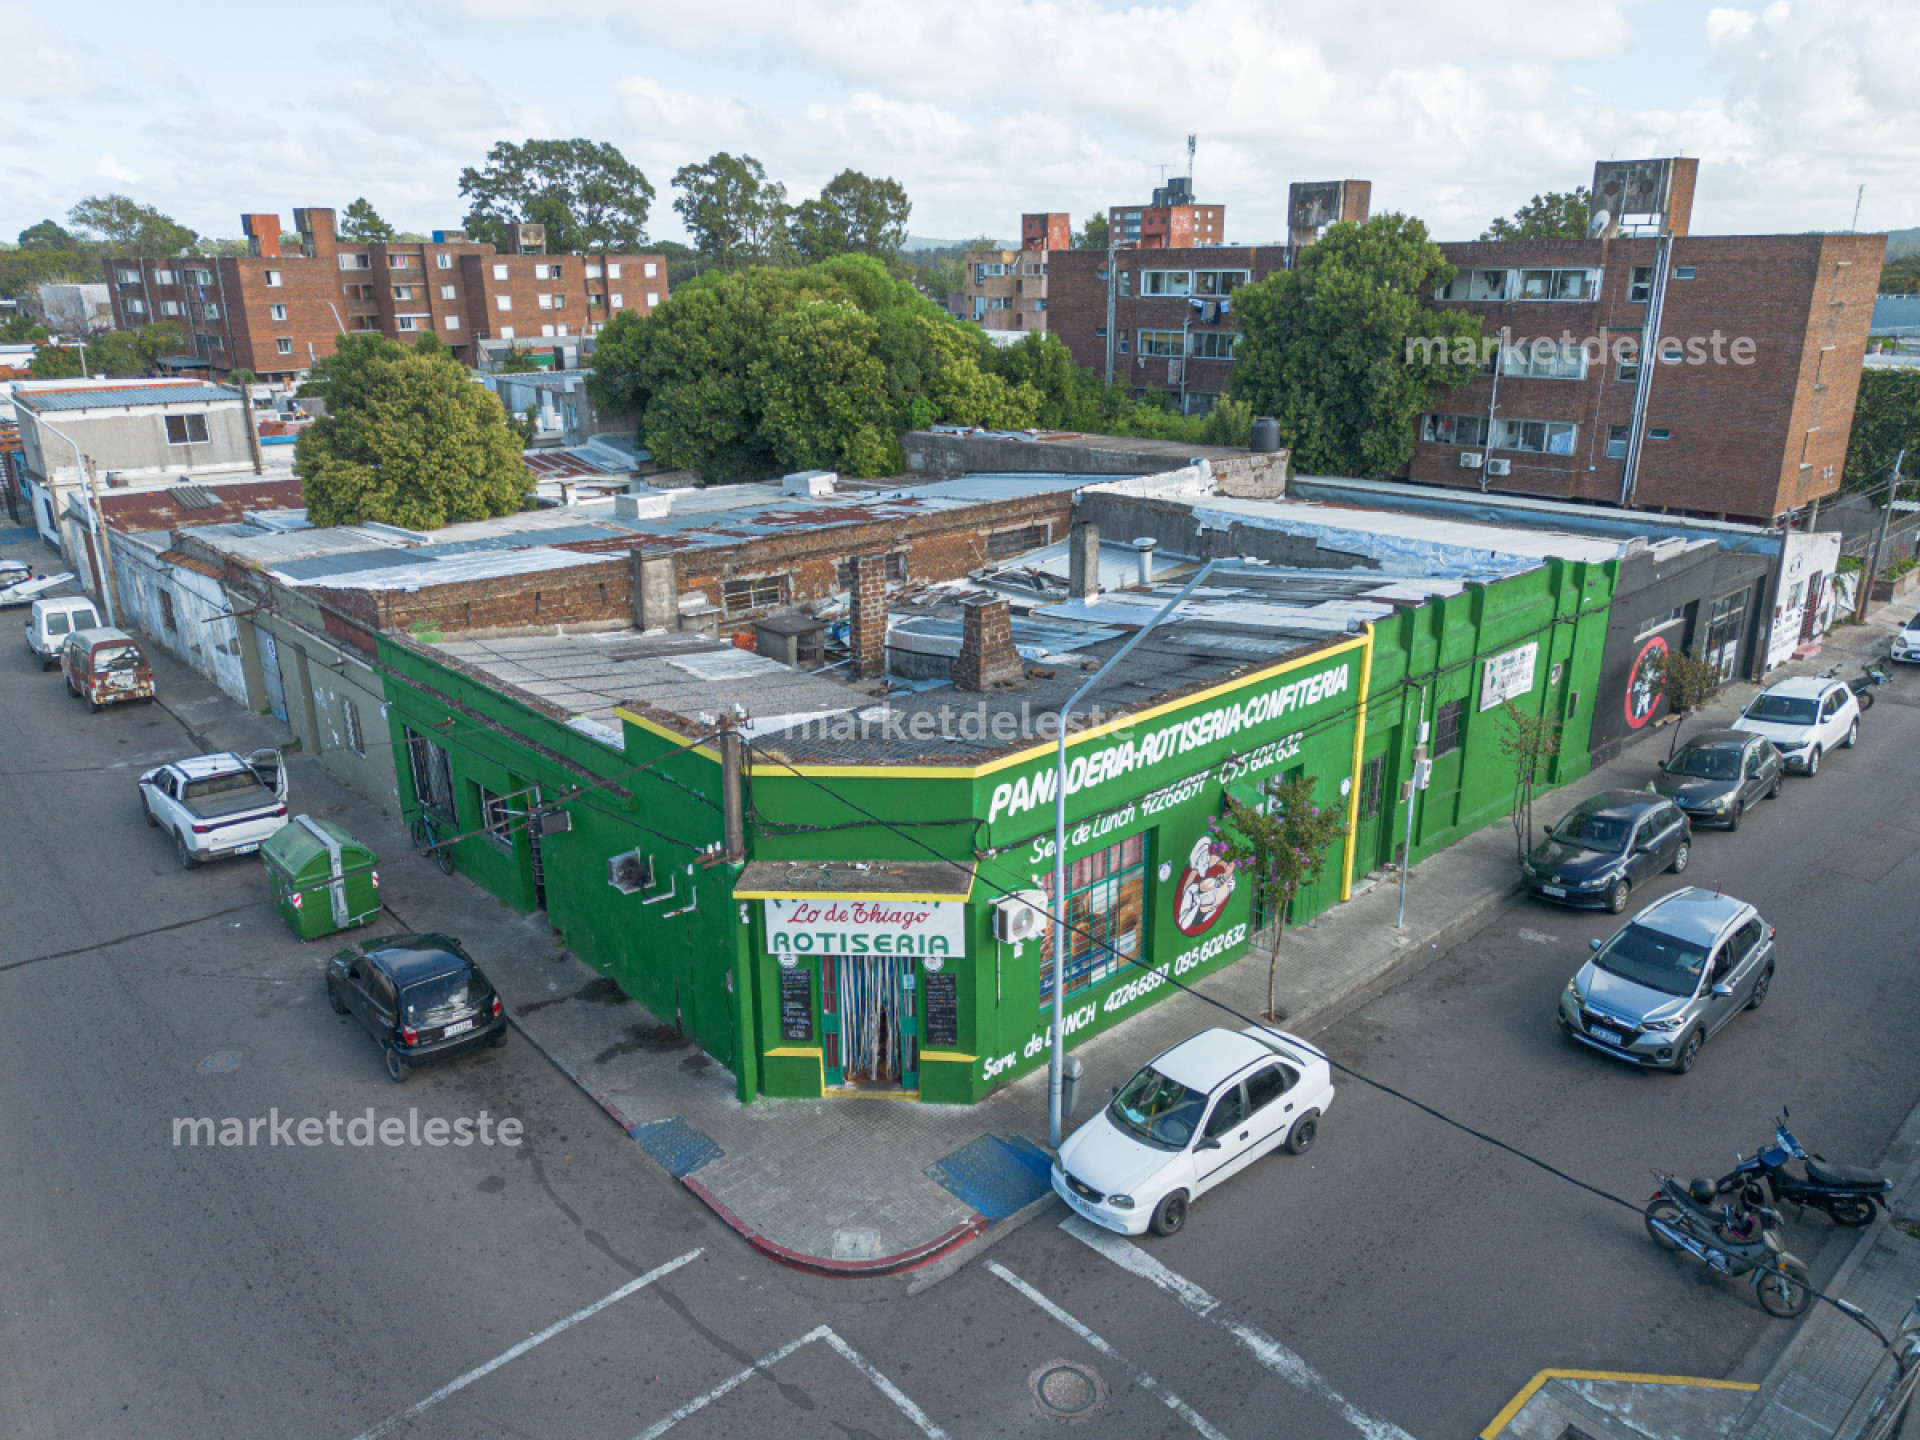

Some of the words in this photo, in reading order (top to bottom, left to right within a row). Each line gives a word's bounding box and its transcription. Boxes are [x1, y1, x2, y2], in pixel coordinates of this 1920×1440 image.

[1072, 820, 1090, 846] de
[1092, 801, 1135, 838] Lunch
[787, 902, 822, 924] Lo
[824, 902, 849, 923] de
[851, 902, 931, 930] Thiago
[773, 932, 950, 955] ROTISERIA
[1023, 1032, 1043, 1058] de
